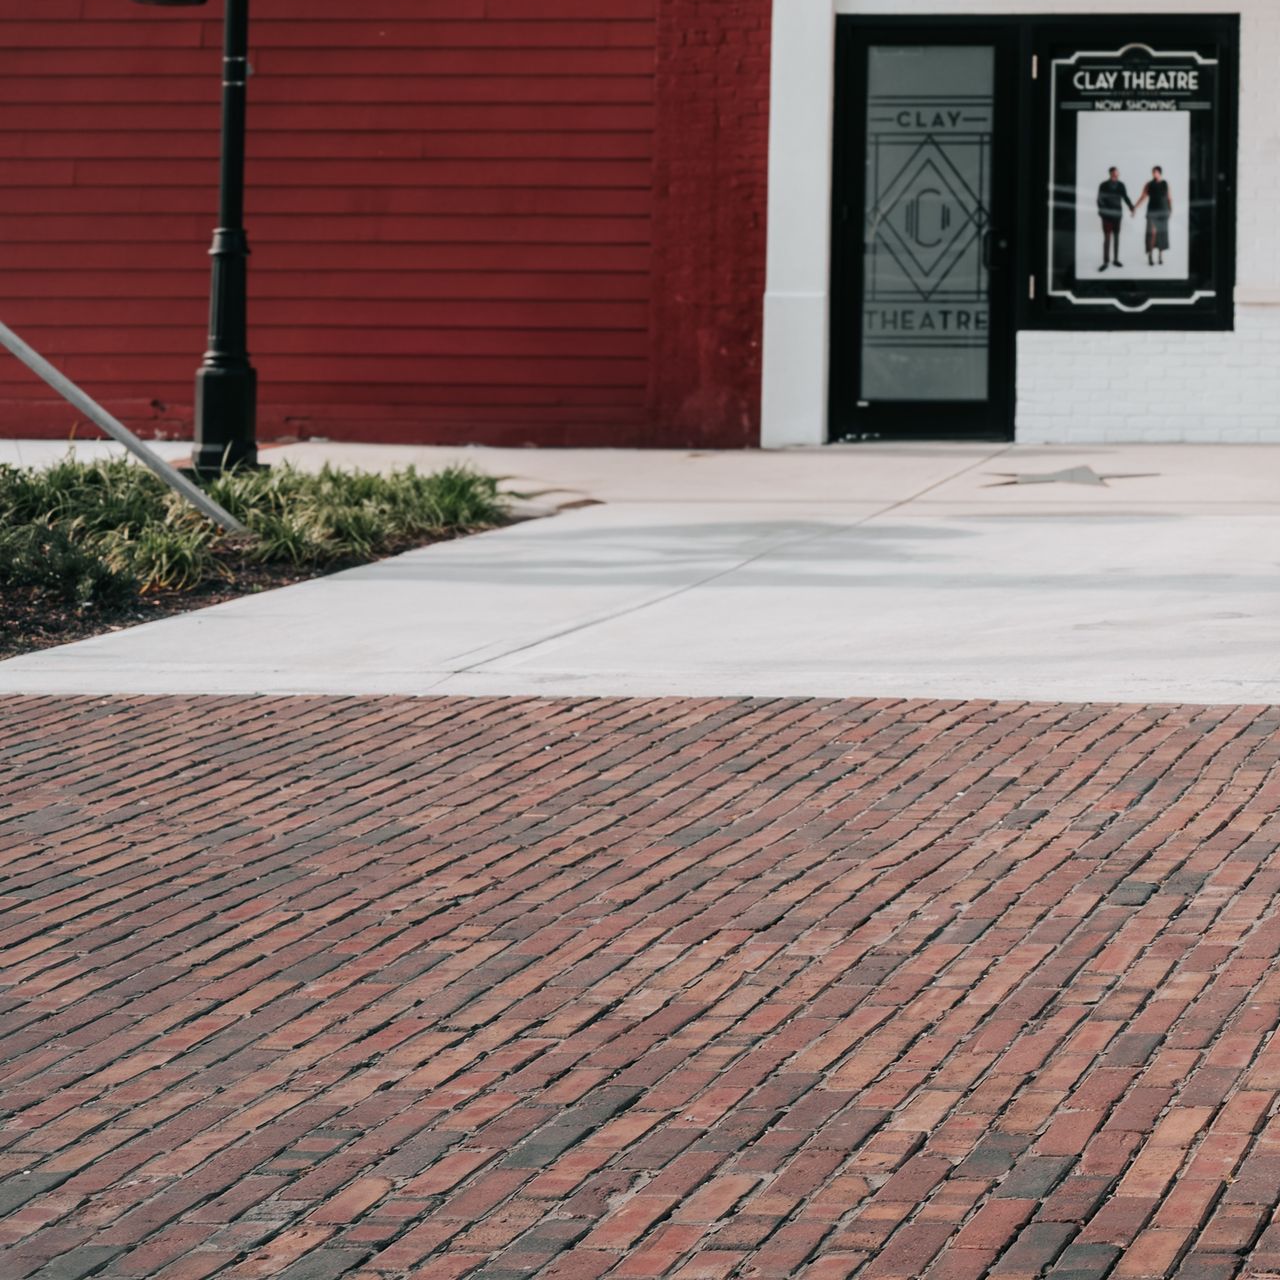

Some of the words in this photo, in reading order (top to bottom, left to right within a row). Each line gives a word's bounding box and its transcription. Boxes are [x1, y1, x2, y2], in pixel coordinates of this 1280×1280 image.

[1072, 71, 1118, 90] CLAY
[1121, 70, 1199, 91] THEATRE
[1094, 100, 1123, 111] NOW
[1126, 99, 1178, 112] SHOWING
[896, 110, 962, 128] CLAY
[866, 309, 989, 331] THEATRE
